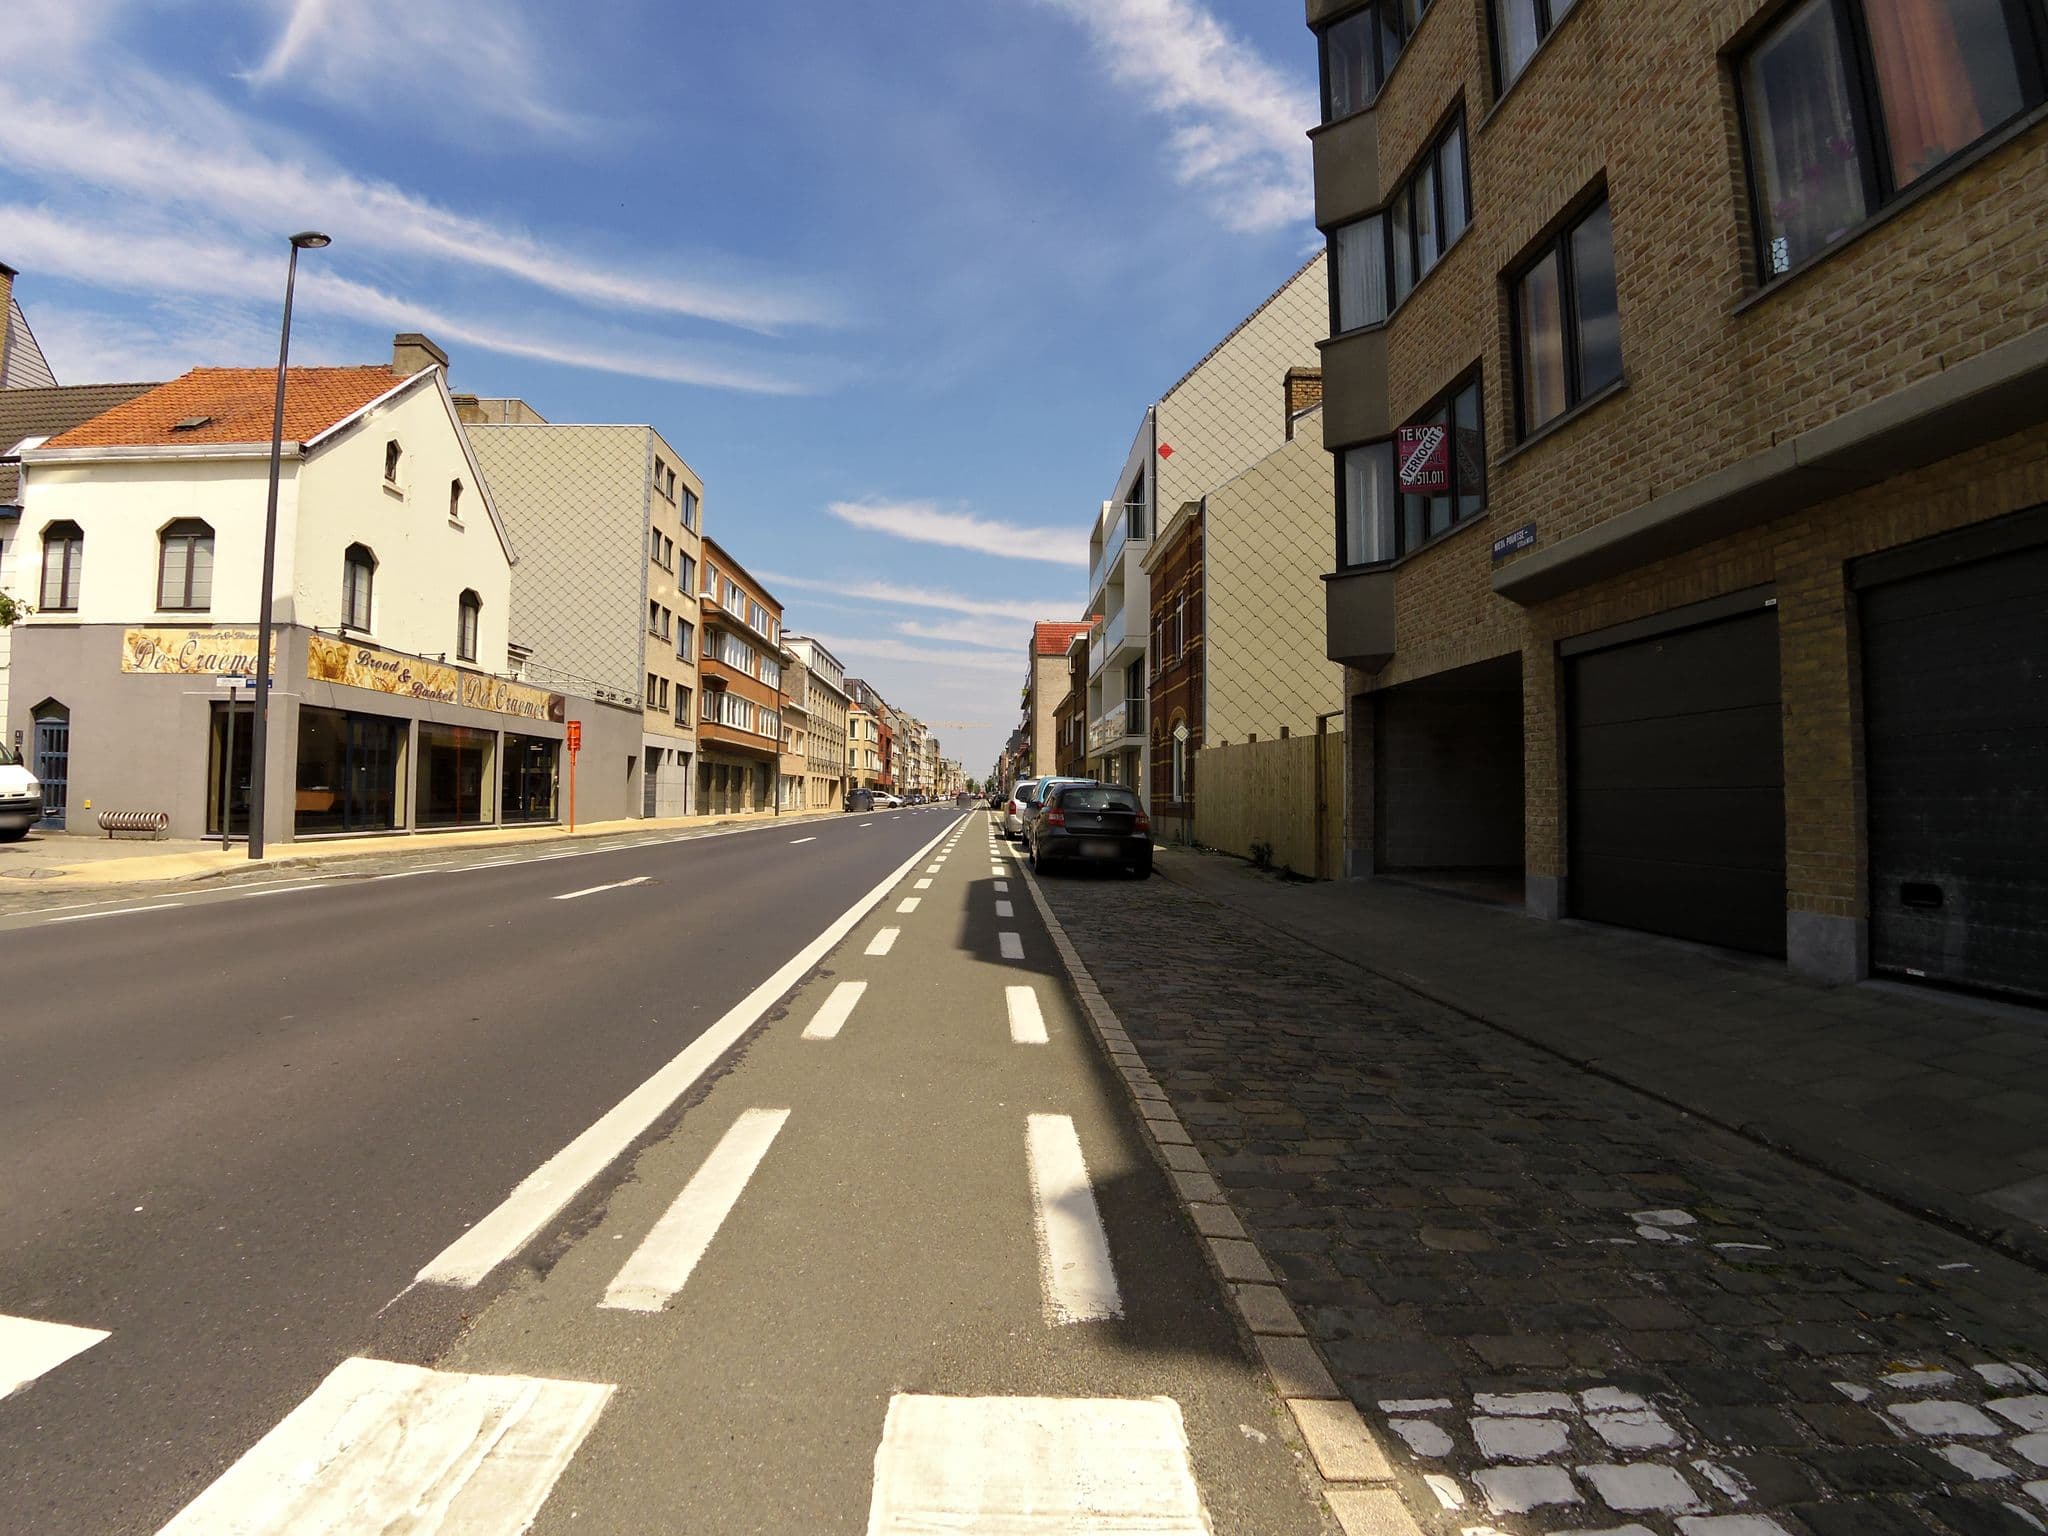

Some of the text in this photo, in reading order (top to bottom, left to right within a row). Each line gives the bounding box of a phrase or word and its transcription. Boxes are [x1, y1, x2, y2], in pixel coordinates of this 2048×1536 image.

[1401, 428, 1413, 441] TE
[1401, 430, 1442, 478] VERKOCHT
[133, 638, 258, 670] De Craeme
[355, 649, 401, 673] Brood
[398, 668, 411, 683] &
[411, 681, 458, 701] Banket
